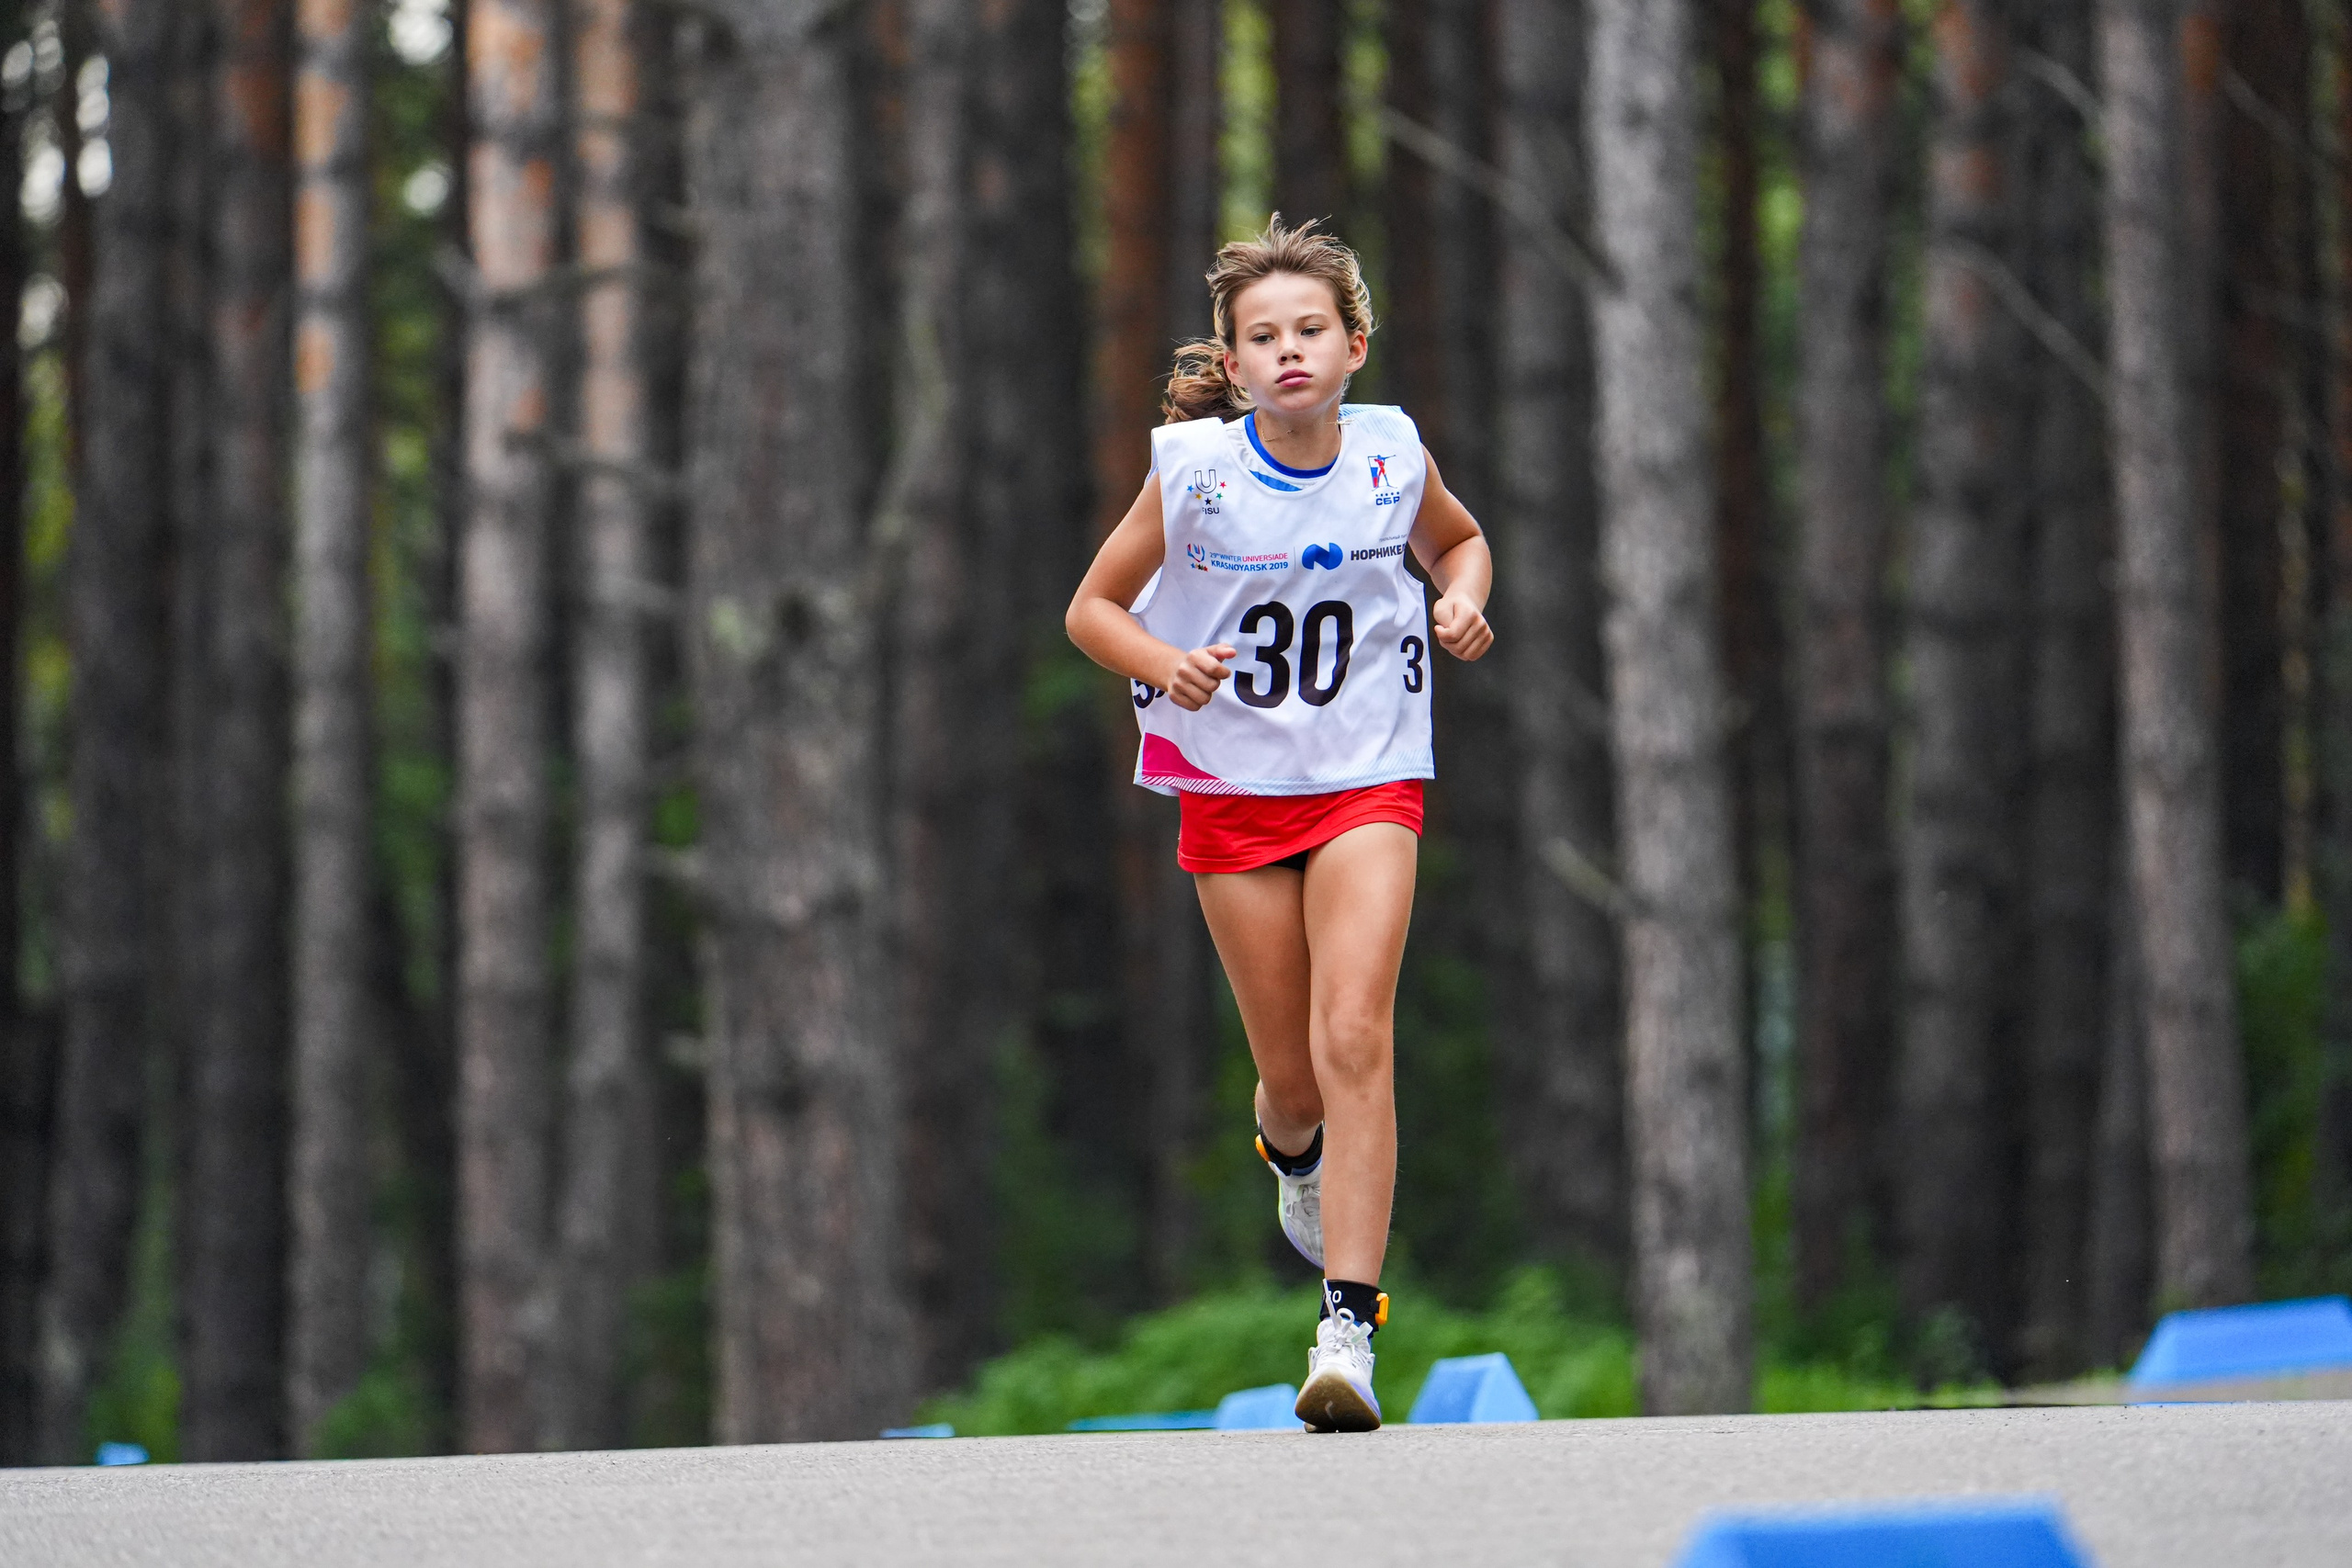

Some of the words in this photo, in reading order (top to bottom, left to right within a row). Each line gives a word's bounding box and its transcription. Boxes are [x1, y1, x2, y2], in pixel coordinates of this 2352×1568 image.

[1375, 496, 1400, 506] СБР
[1220, 554, 1241, 562] WINTER
[1242, 553, 1288, 562] UNIVERSIADE
[1211, 559, 1268, 571] KRASNOYARSK
[1269, 561, 1289, 570] 2019
[1235, 600, 1353, 708] 30
[1400, 635, 1424, 694] 3
